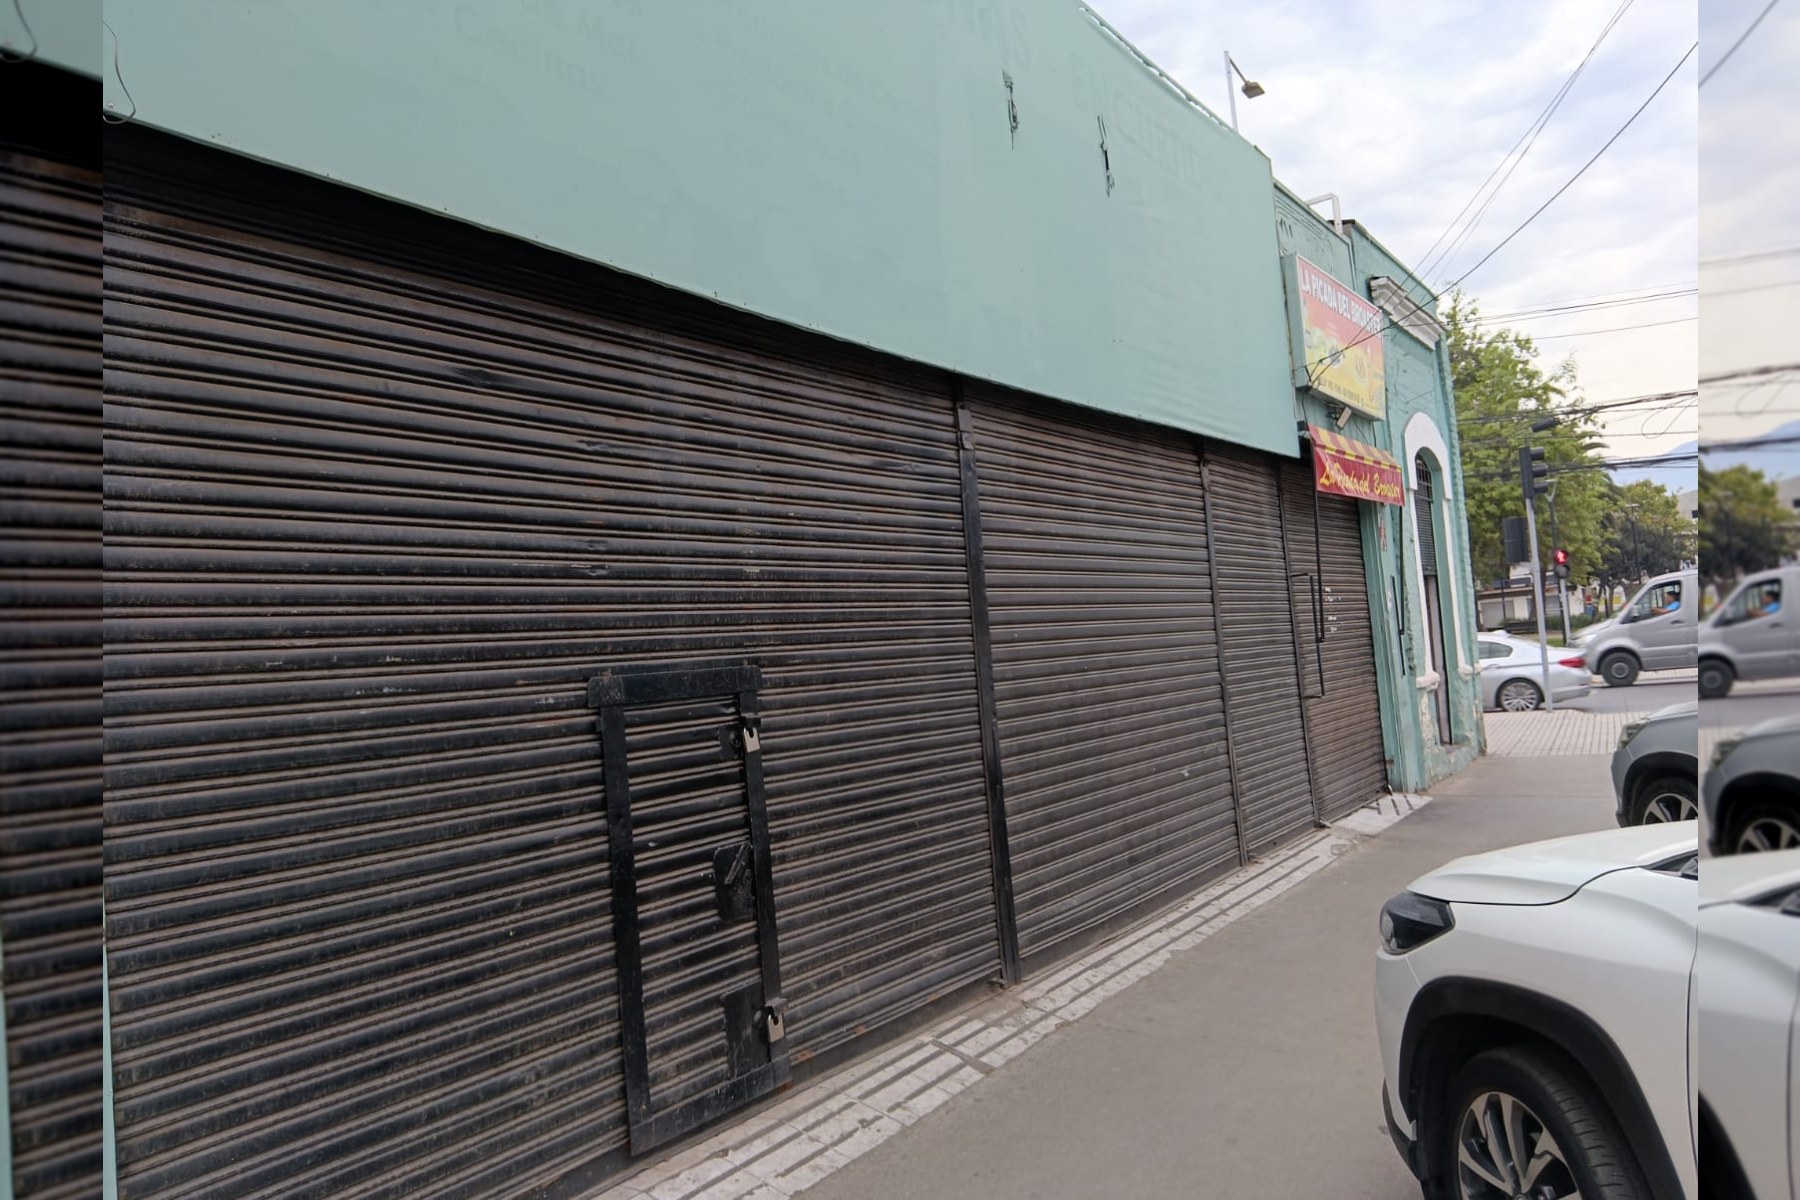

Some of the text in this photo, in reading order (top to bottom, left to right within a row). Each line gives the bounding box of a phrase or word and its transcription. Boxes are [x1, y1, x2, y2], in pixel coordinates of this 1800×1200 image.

[1300, 265, 1312, 295] LA
[1311, 273, 1339, 313] PICADA
[1337, 290, 1351, 320] DEL
